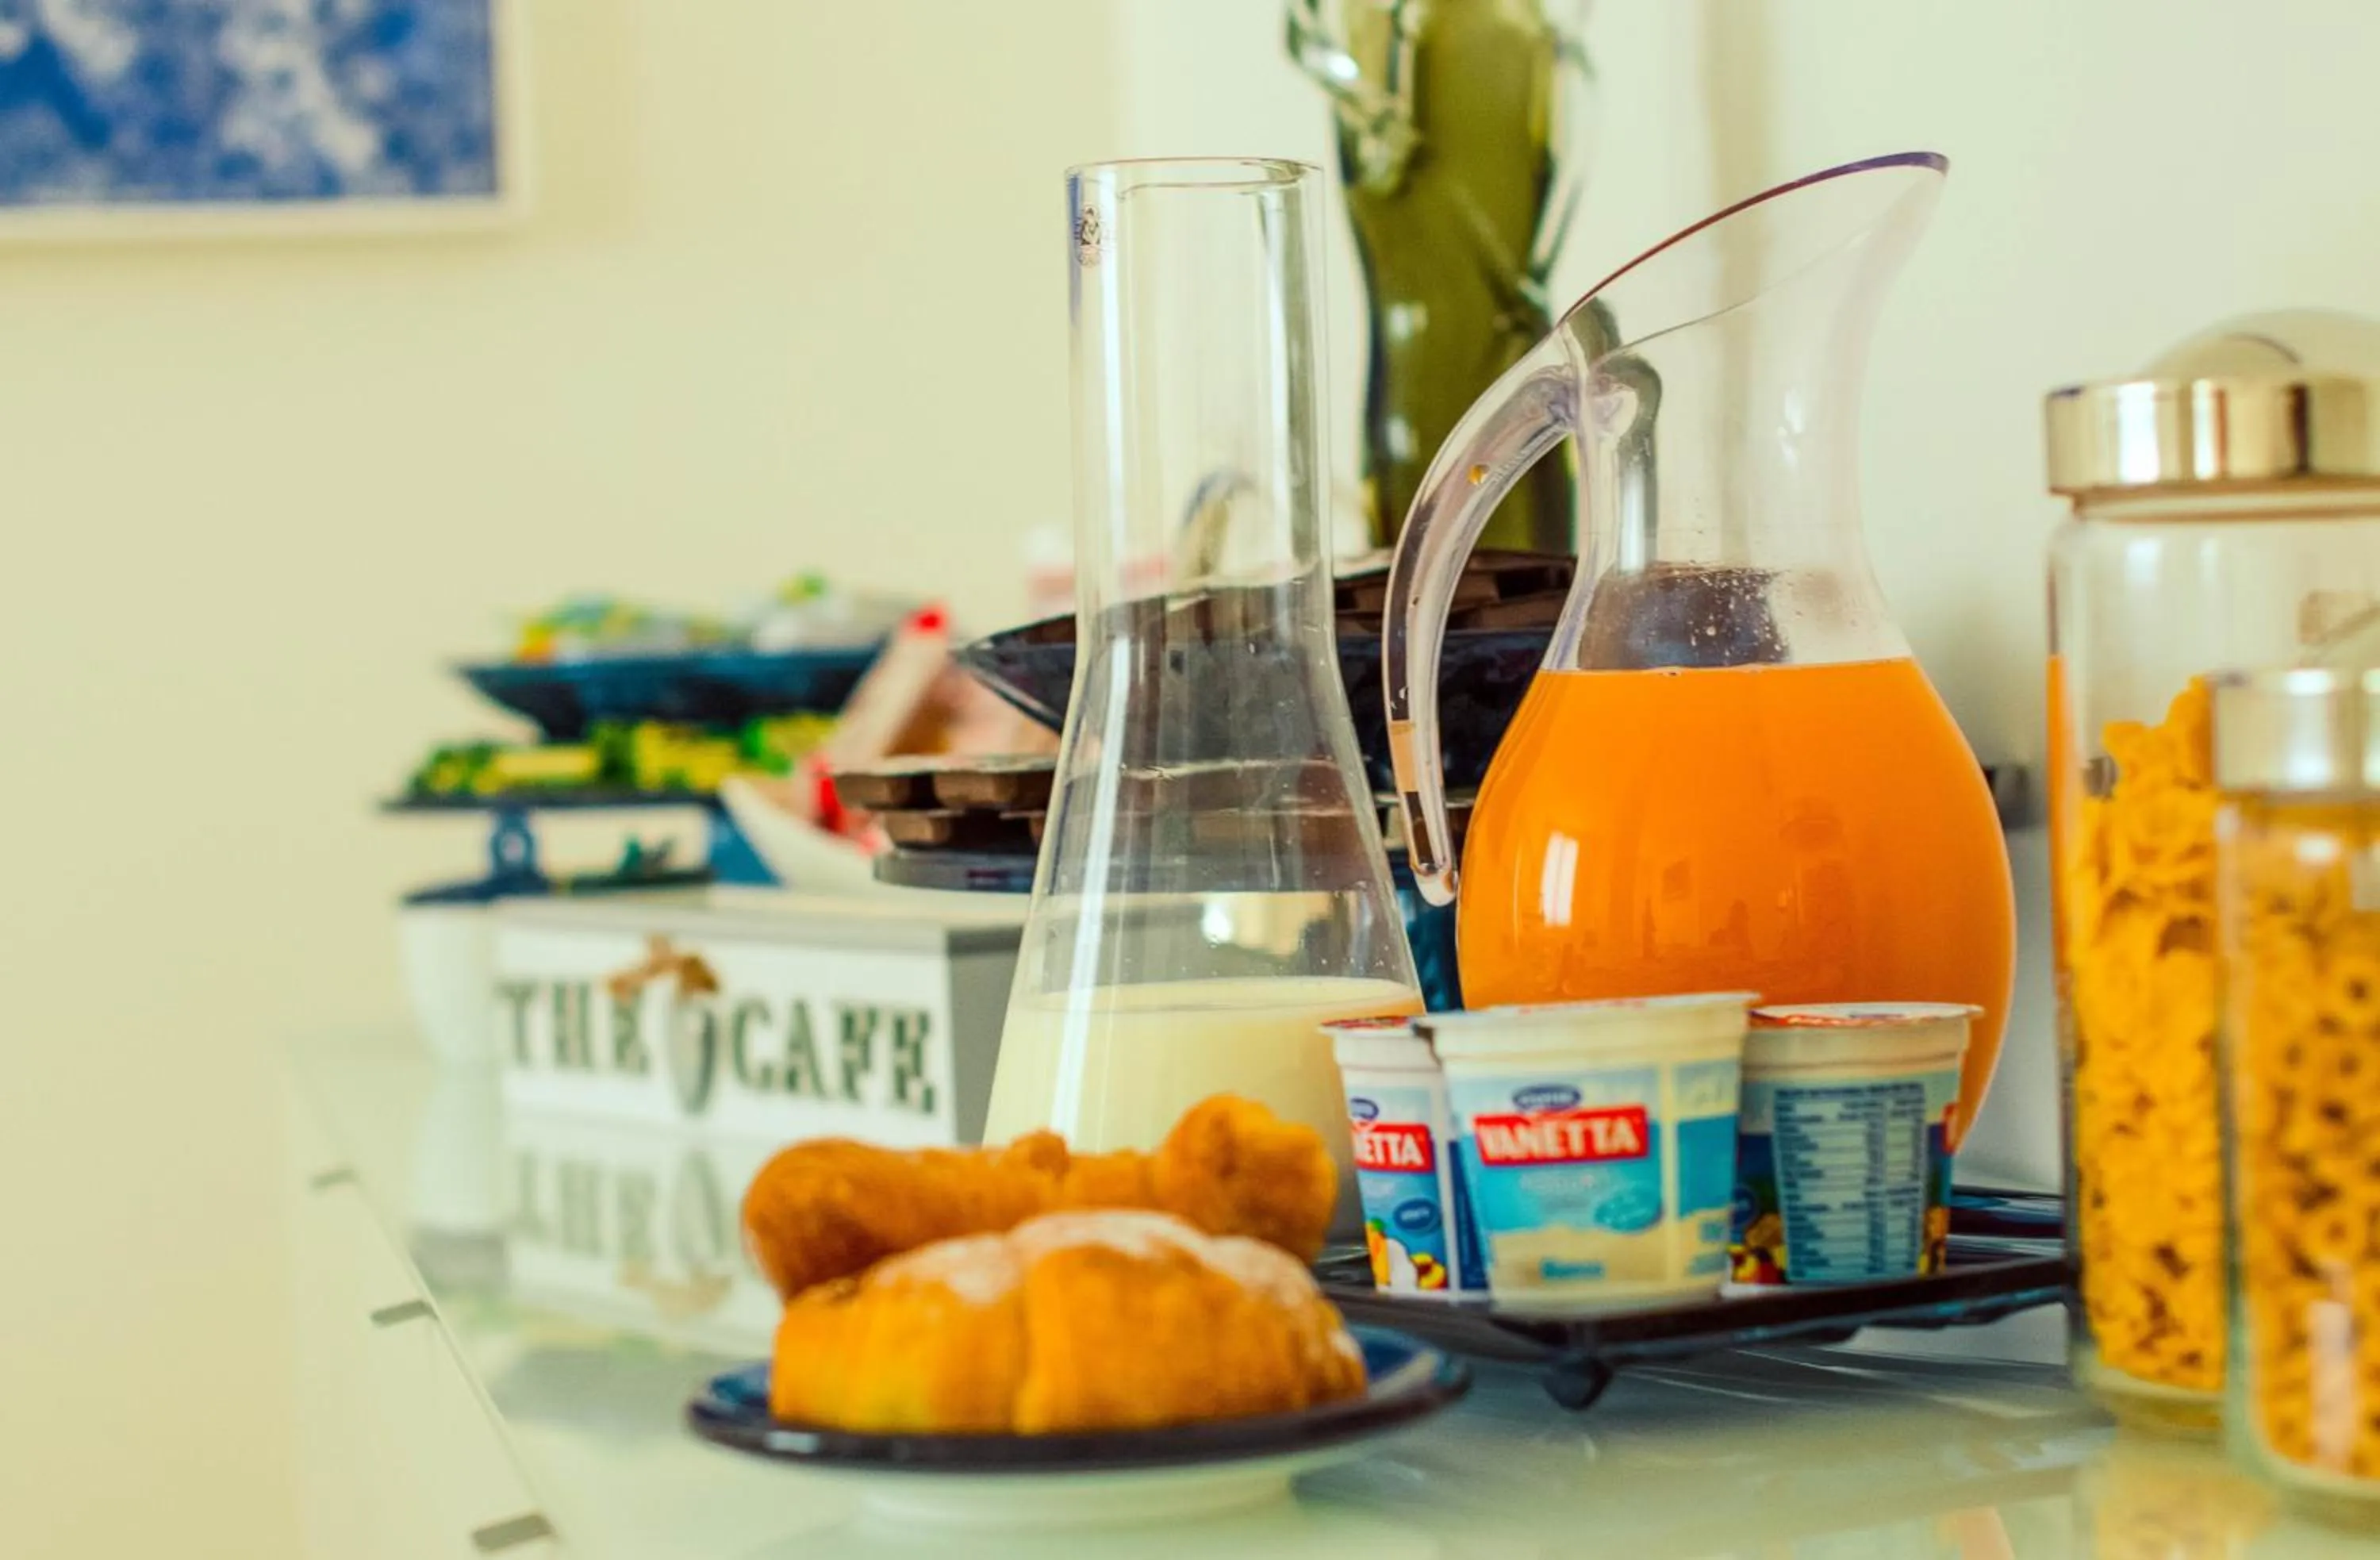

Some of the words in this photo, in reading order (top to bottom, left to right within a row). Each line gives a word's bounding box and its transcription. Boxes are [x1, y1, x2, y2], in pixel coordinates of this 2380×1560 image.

[497, 980, 651, 1071] THE
[731, 997, 938, 1112] CAFE
[1354, 1132, 1424, 1165] ETTA
[1478, 1117, 1640, 1159] VANETTA
